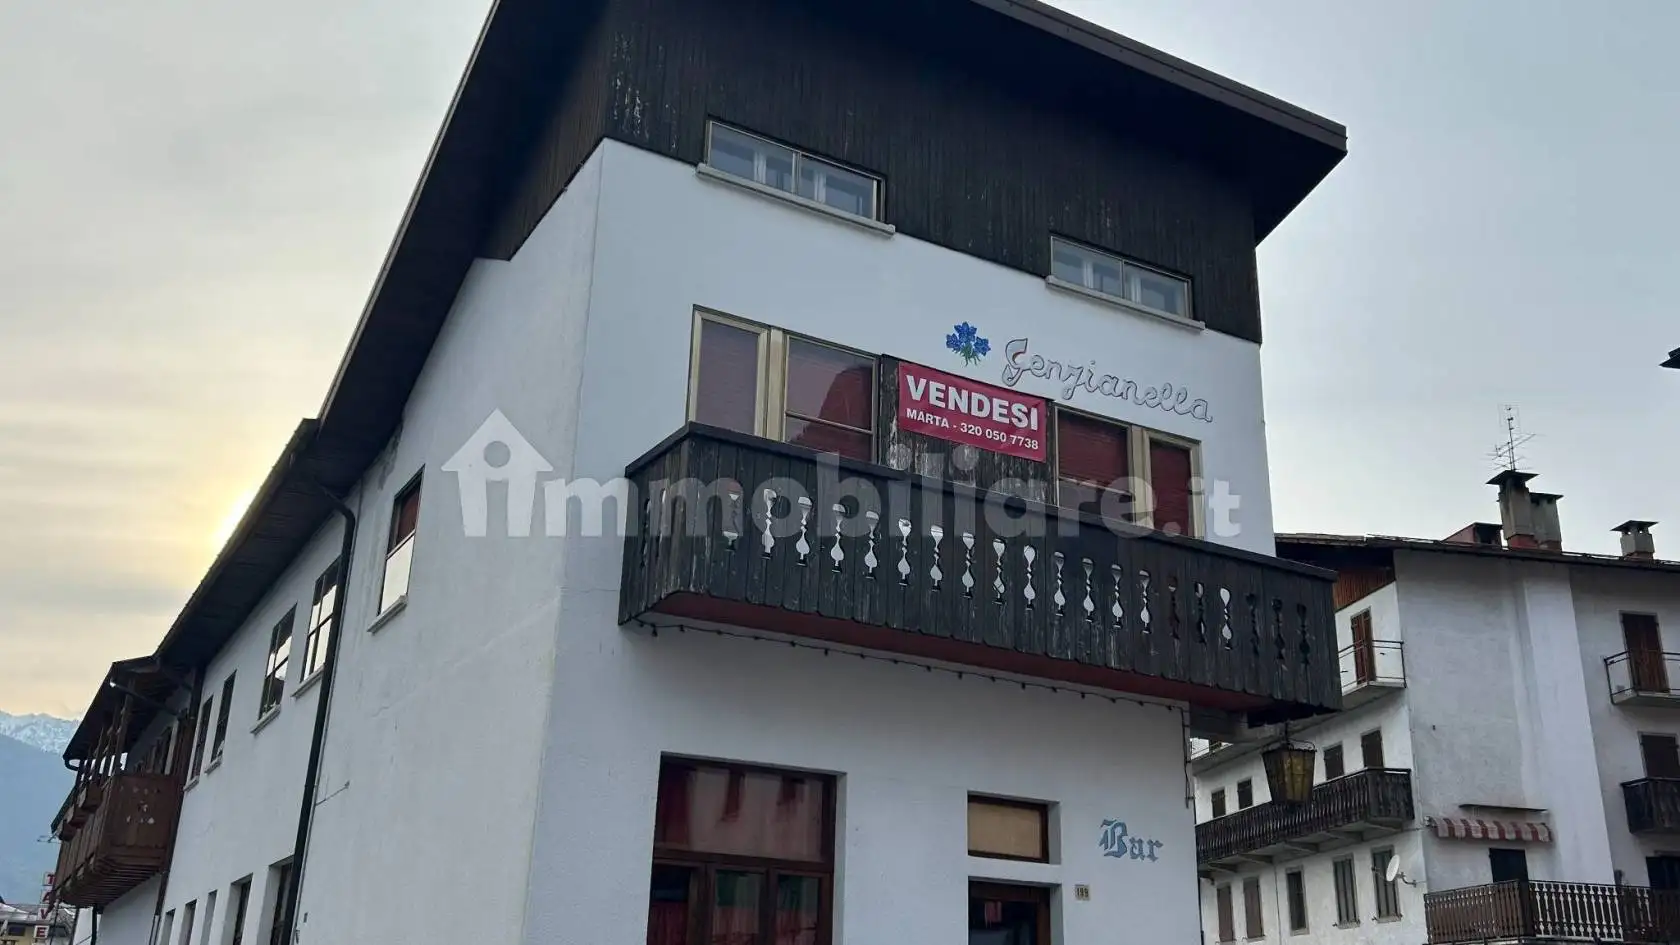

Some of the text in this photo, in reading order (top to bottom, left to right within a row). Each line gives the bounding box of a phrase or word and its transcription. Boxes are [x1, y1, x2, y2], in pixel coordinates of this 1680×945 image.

[905, 374, 1038, 431] VENDESI
[1002, 338, 1213, 422] Genzianella
[905, 408, 950, 429] MARTA
[960, 422, 983, 436] 320
[985, 429, 1007, 442] 050
[1009, 434, 1039, 450] 7738
[1099, 819, 1164, 862] Bar
